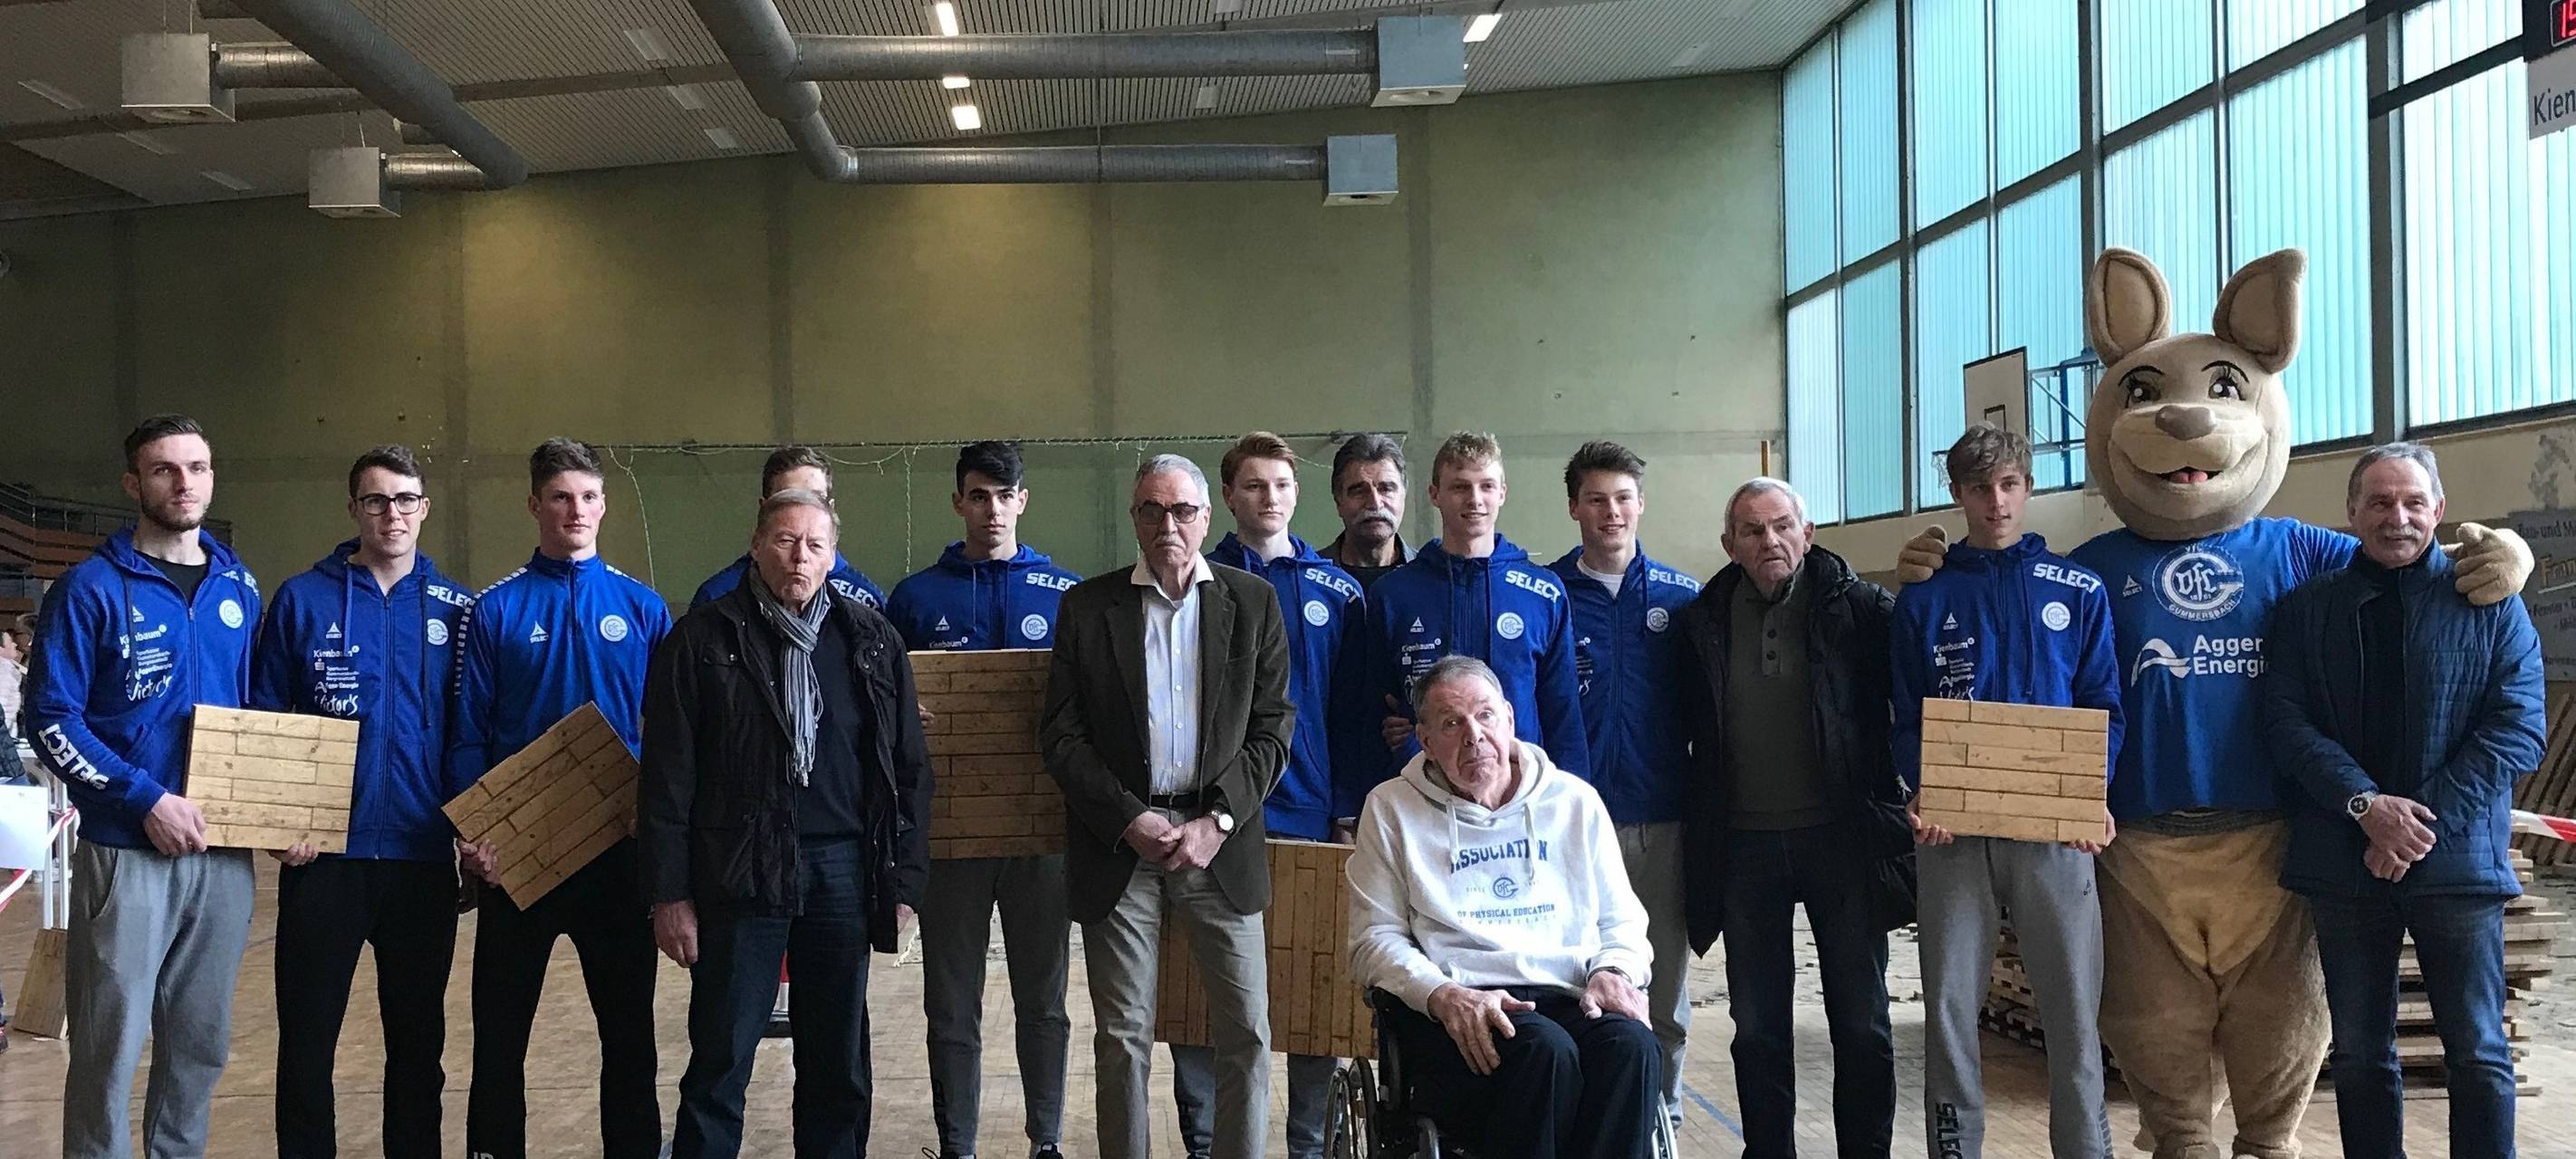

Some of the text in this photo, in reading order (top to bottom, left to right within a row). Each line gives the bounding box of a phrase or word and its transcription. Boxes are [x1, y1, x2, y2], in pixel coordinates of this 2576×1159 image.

[2533, 88, 2576, 126] Kien
[1025, 572, 1078, 592] SELEC
[1304, 568, 1361, 604] SELECT
[1504, 570, 1562, 603] SELECT
[1648, 569, 1701, 594] SELECT
[2033, 562, 2101, 594] SELECT
[427, 585, 471, 608] SELEC
[120, 630, 162, 645] Kibaum
[2193, 634, 2264, 657] Agger
[2193, 656, 2264, 678] Energi
[38, 723, 110, 790] SELECT
[1450, 838, 1548, 874] SSOCIATIN
[1469, 908, 1511, 919] PHYSICAL
[1514, 904, 1555, 916] EDUCATION
